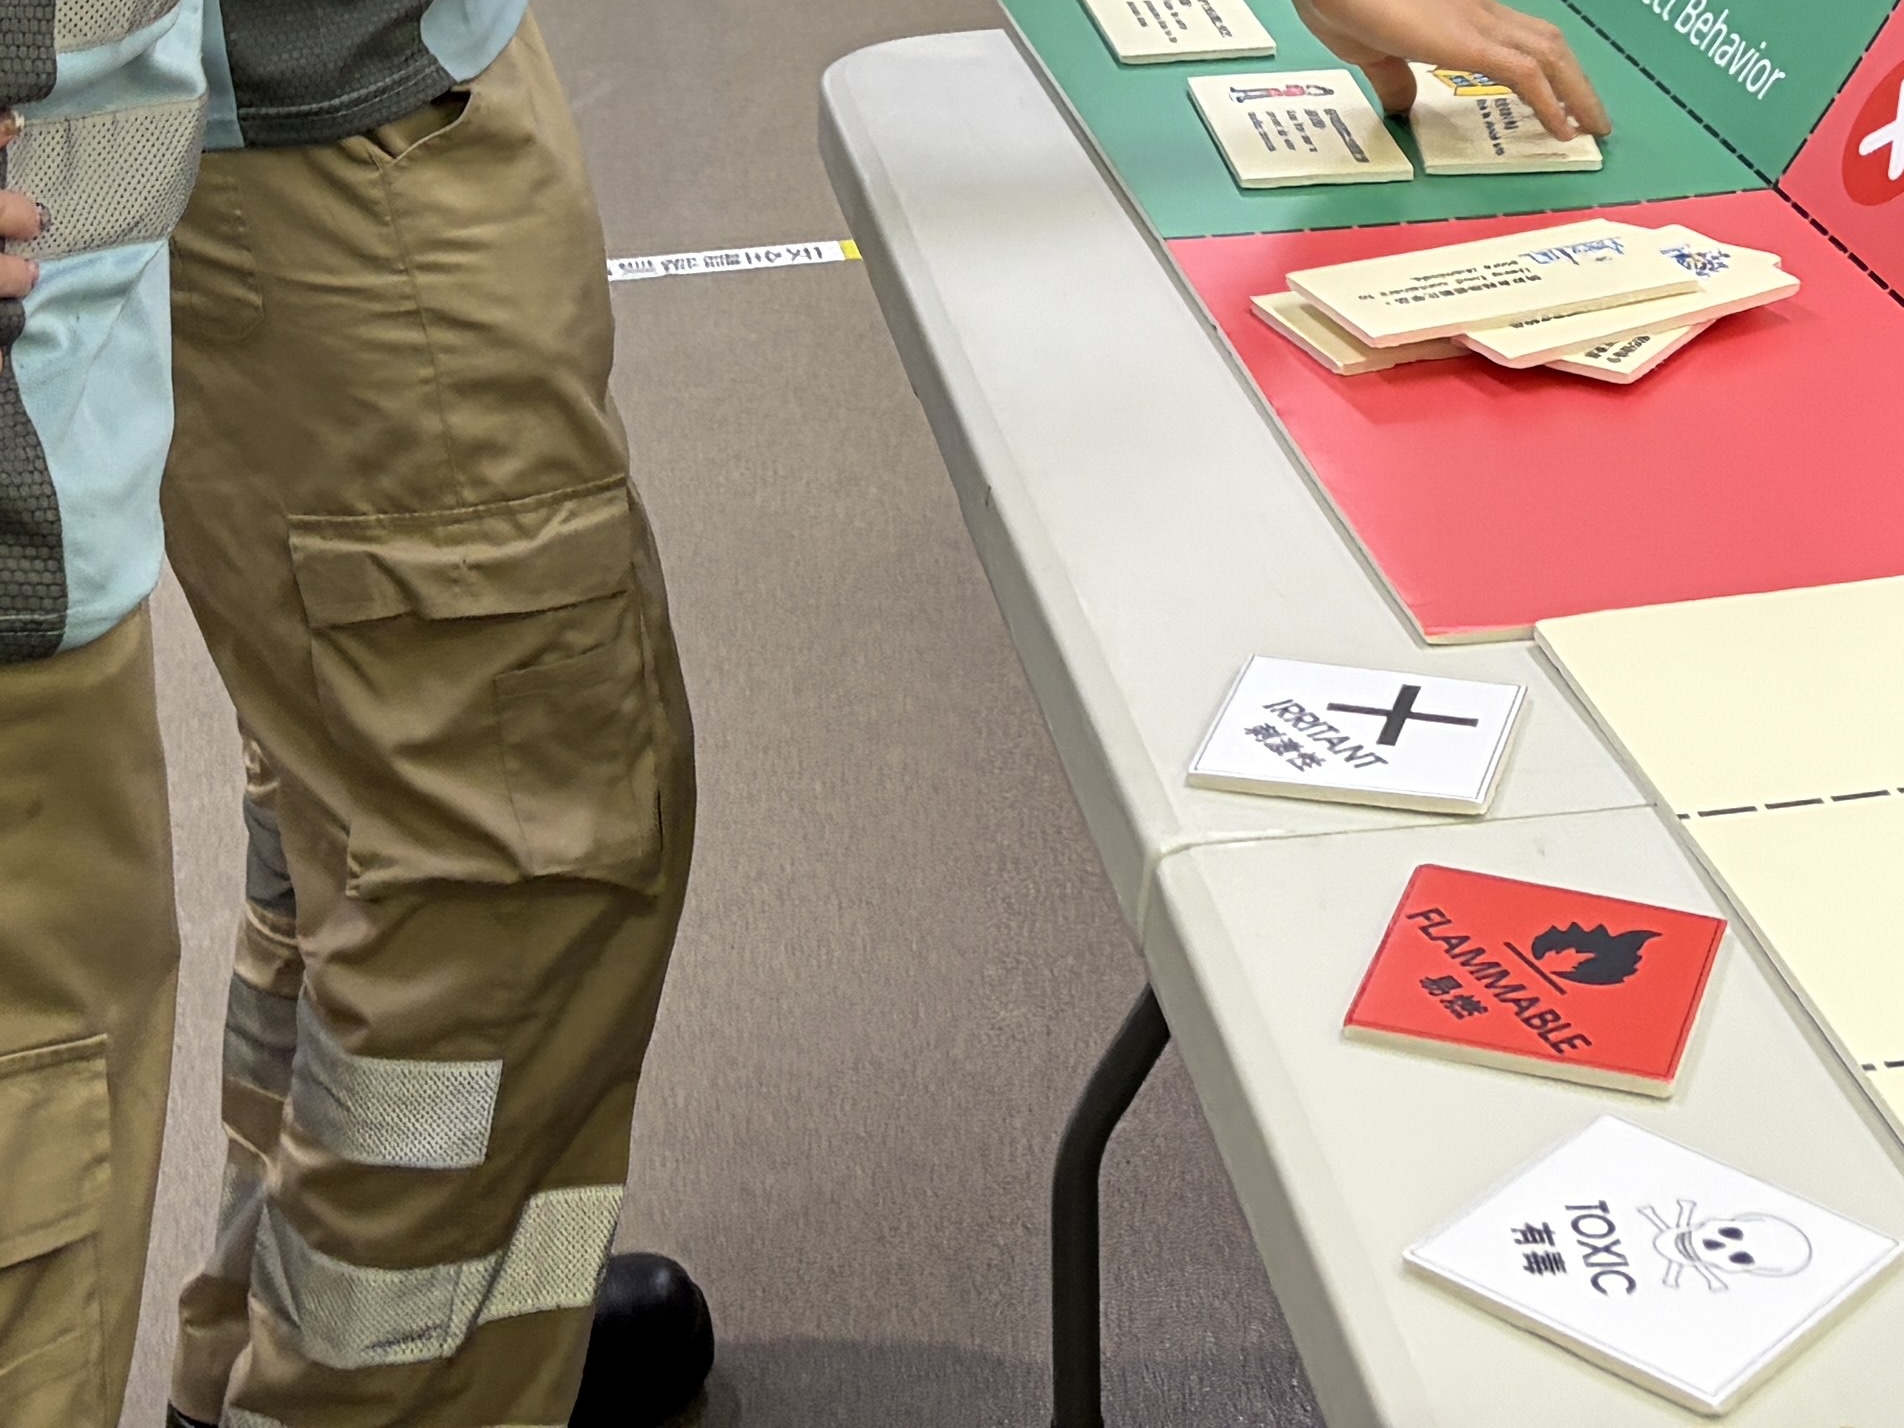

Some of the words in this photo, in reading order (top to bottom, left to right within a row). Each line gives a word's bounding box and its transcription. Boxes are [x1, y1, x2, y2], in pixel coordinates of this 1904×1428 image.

[1262, 698, 1389, 768] IRRITANT
[1406, 907, 1593, 1054] FLAMMABLE
[1419, 974, 1489, 1020] 易燃
[1511, 1221, 1568, 1277] 有毒
[1564, 1199, 1637, 1297] TOXIC
